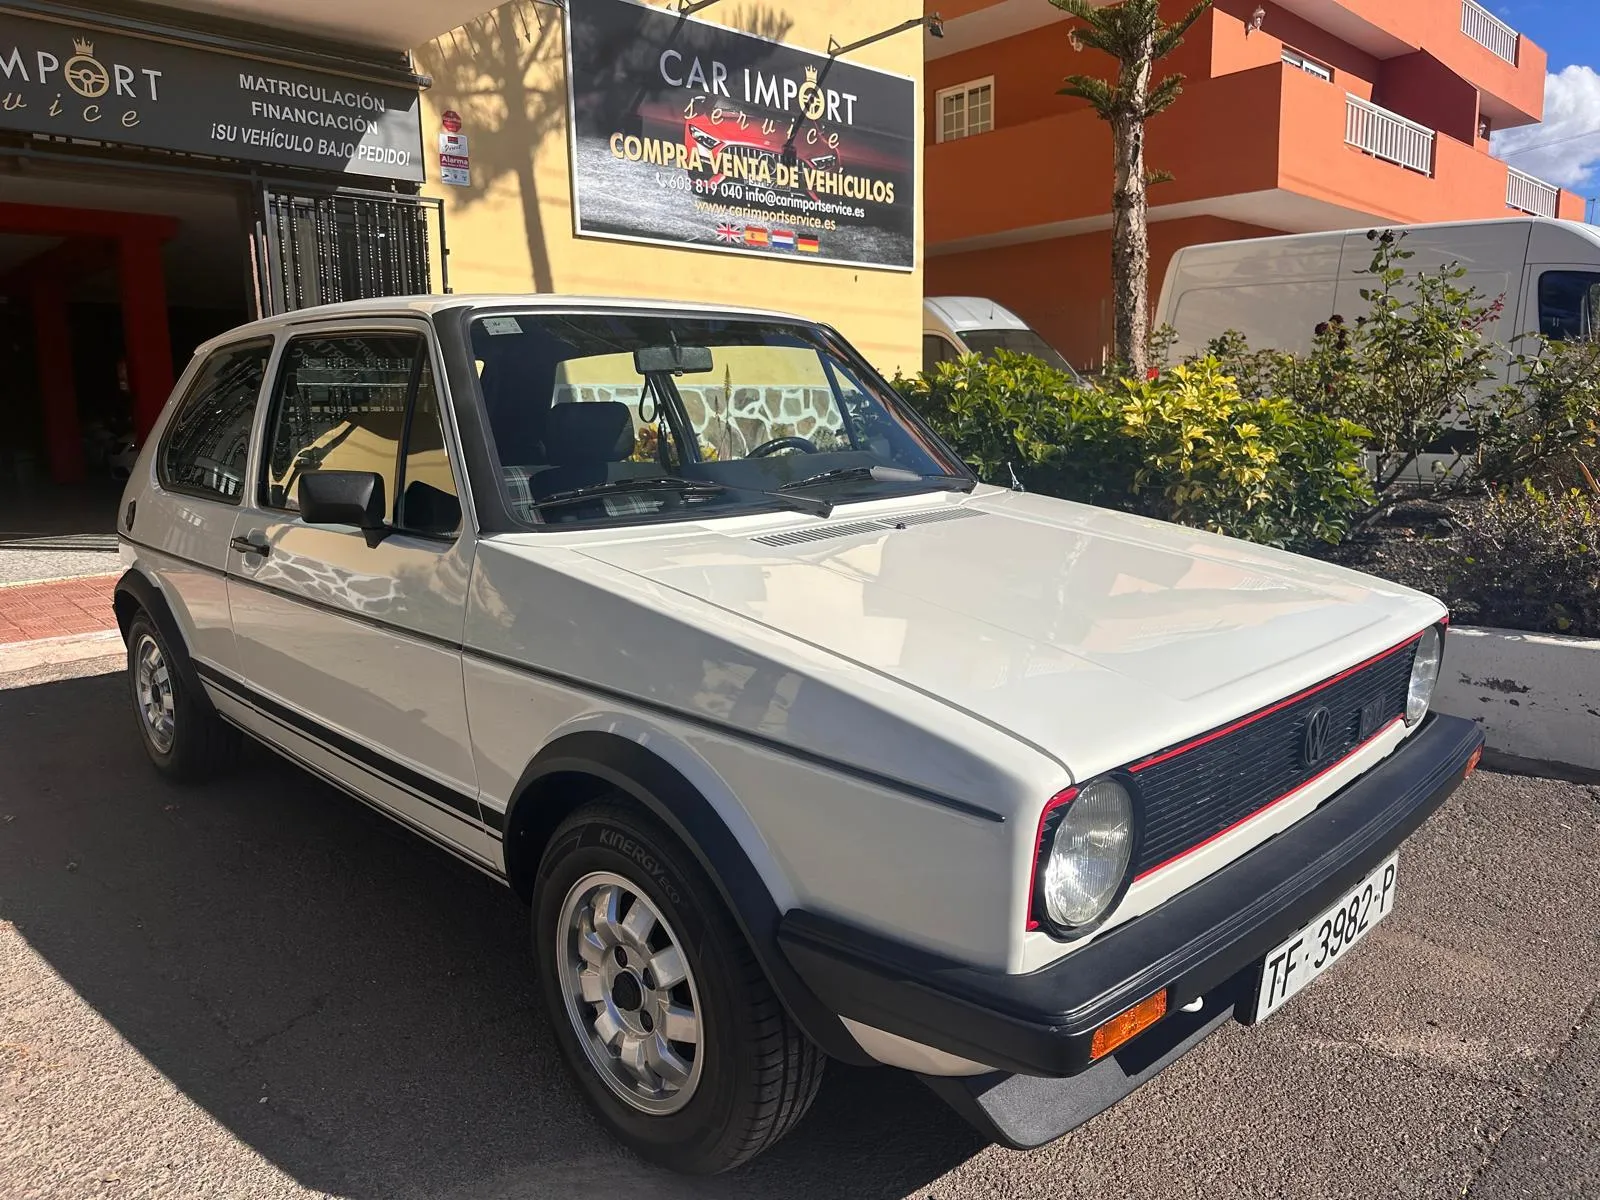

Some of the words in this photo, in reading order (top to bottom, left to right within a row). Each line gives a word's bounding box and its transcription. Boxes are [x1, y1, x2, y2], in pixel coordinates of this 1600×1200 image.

[239, 74, 385, 112] MATRICULACIÓN
[660, 49, 731, 98] CAR
[744, 68, 858, 126] IMPORT
[251, 101, 379, 135] FINANCIACIÓN
[241, 126, 314, 153] VEHÍCULO
[317, 139, 355, 159] BAJO
[357, 144, 411, 167] PEDIDO!
[442, 156, 468, 165] Alarma
[609, 132, 703, 172] COMPRA
[709, 151, 772, 185] VENTA
[776, 162, 800, 189] DE
[803, 167, 896, 205] VEHÍCULOS
[669, 175, 693, 192] 603
[695, 179, 719, 195] 819
[720, 183, 743, 200] 040
[745, 186, 866, 219] info@carimportservice.es
[695, 200, 837, 231] www.carimportservice.es
[600, 828, 664, 876] KINERGY
